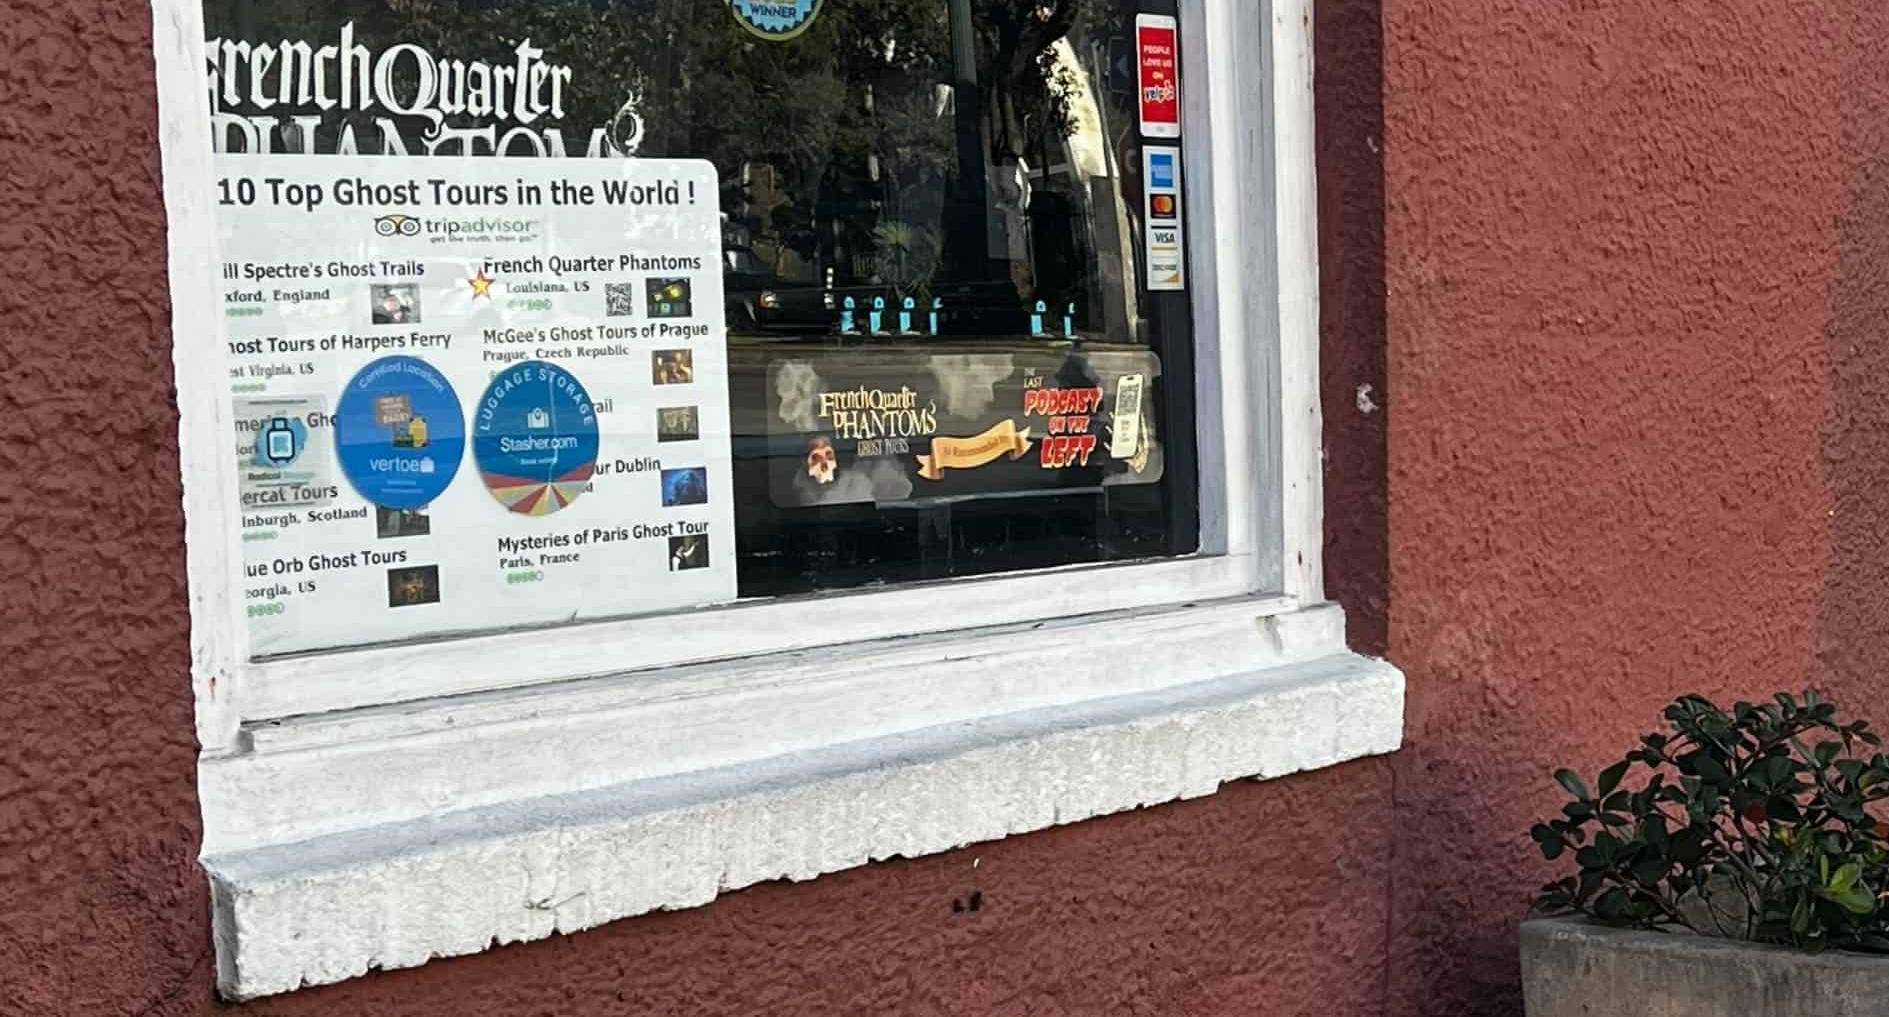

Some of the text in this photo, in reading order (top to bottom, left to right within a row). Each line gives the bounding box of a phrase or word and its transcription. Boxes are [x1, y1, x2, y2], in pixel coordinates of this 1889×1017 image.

[751, 5, 797, 18] WINNER
[1144, 45, 1170, 55] PEOPLE
[1143, 58, 1172, 67] LOVE US
[219, 178, 255, 206] 10
[265, 178, 323, 211] Top
[333, 178, 420, 206] Ghost
[428, 179, 508, 206] Tours
[517, 178, 540, 206] in
[550, 178, 594, 206] the
[603, 178, 680, 206] World
[426, 216, 533, 235] tripadvisor
[1155, 233, 1175, 244] VISA
[223, 260, 424, 282] ill Spectre's Ghost Trails
[483, 254, 700, 277] French Quarter Phantoms
[225, 289, 330, 303] xford, England
[506, 281, 590, 294] Louisiana, US
[267, 336, 314, 352] Tours
[320, 335, 337, 351] of
[342, 334, 405, 352] Harpers
[411, 332, 450, 350] Ferry
[483, 323, 709, 344] McGee's Ghost Tours of Prague
[483, 346, 630, 362] Prague, Czech Republic
[300, 363, 314, 374] US
[1024, 375, 1044, 388] LAST
[480, 368, 532, 431] LUGGAGE
[538, 367, 594, 426] STORAGE
[592, 398, 612, 414] rail
[1024, 386, 1103, 417] PODCAST
[833, 401, 936, 439] PHANTOMS
[1049, 416, 1089, 434] ON THE
[500, 436, 577, 453] Stasher.com
[857, 438, 883, 457] GHOST
[1040, 434, 1096, 469] LEFT
[370, 457, 419, 472] vertoe
[616, 458, 661, 473] Dublin
[242, 484, 338, 504] ercat Tours
[308, 507, 367, 522] Scotland
[498, 521, 709, 554] Mysteries of Paris Ghost Tour
[273, 558, 303, 575] Orb
[309, 552, 356, 571] Ghost
[362, 550, 406, 566] Tours
[500, 553, 580, 568] Paris, France
[298, 581, 315, 593] US
